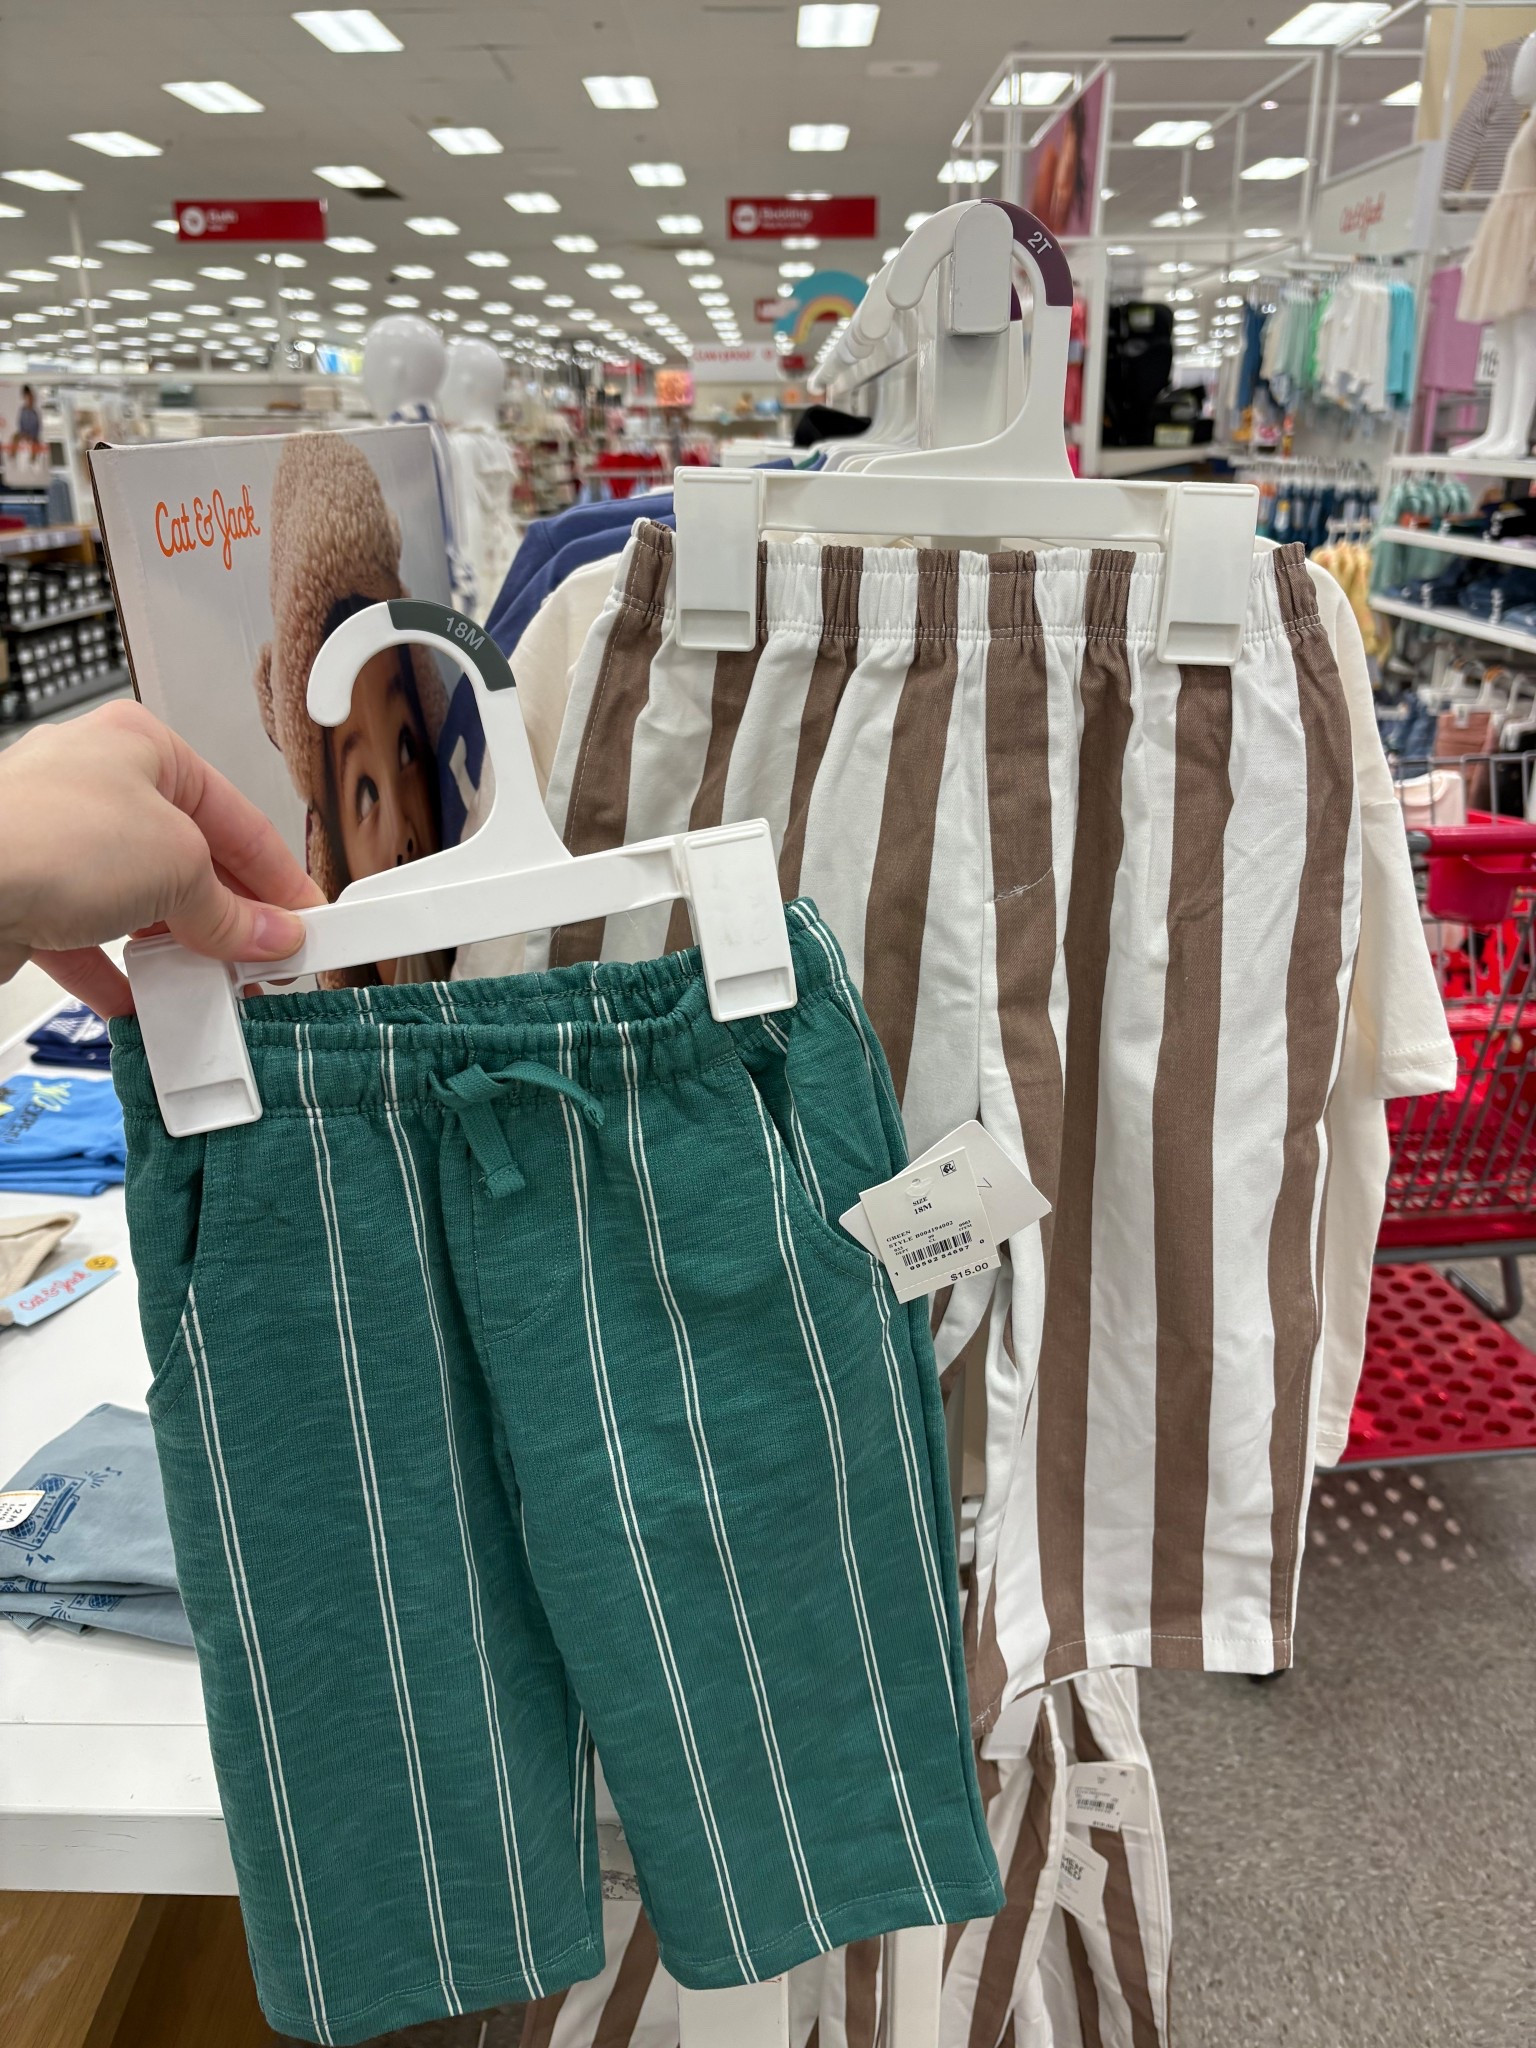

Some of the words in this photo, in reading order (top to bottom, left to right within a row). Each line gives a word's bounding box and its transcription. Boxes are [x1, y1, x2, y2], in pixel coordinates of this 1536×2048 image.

[1027, 231, 1053, 255] 2T
[155, 501, 196, 557] Cat
[193, 497, 214, 547] &
[212, 484, 261, 570] Jack
[445, 616, 486, 651] 18M
[912, 1196, 928, 1206] SIZE
[914, 1202, 933, 1215] 18M
[886, 1230, 911, 1243] GREEN
[888, 1236, 913, 1248] STYLE
[950, 1262, 989, 1282] $15.00
